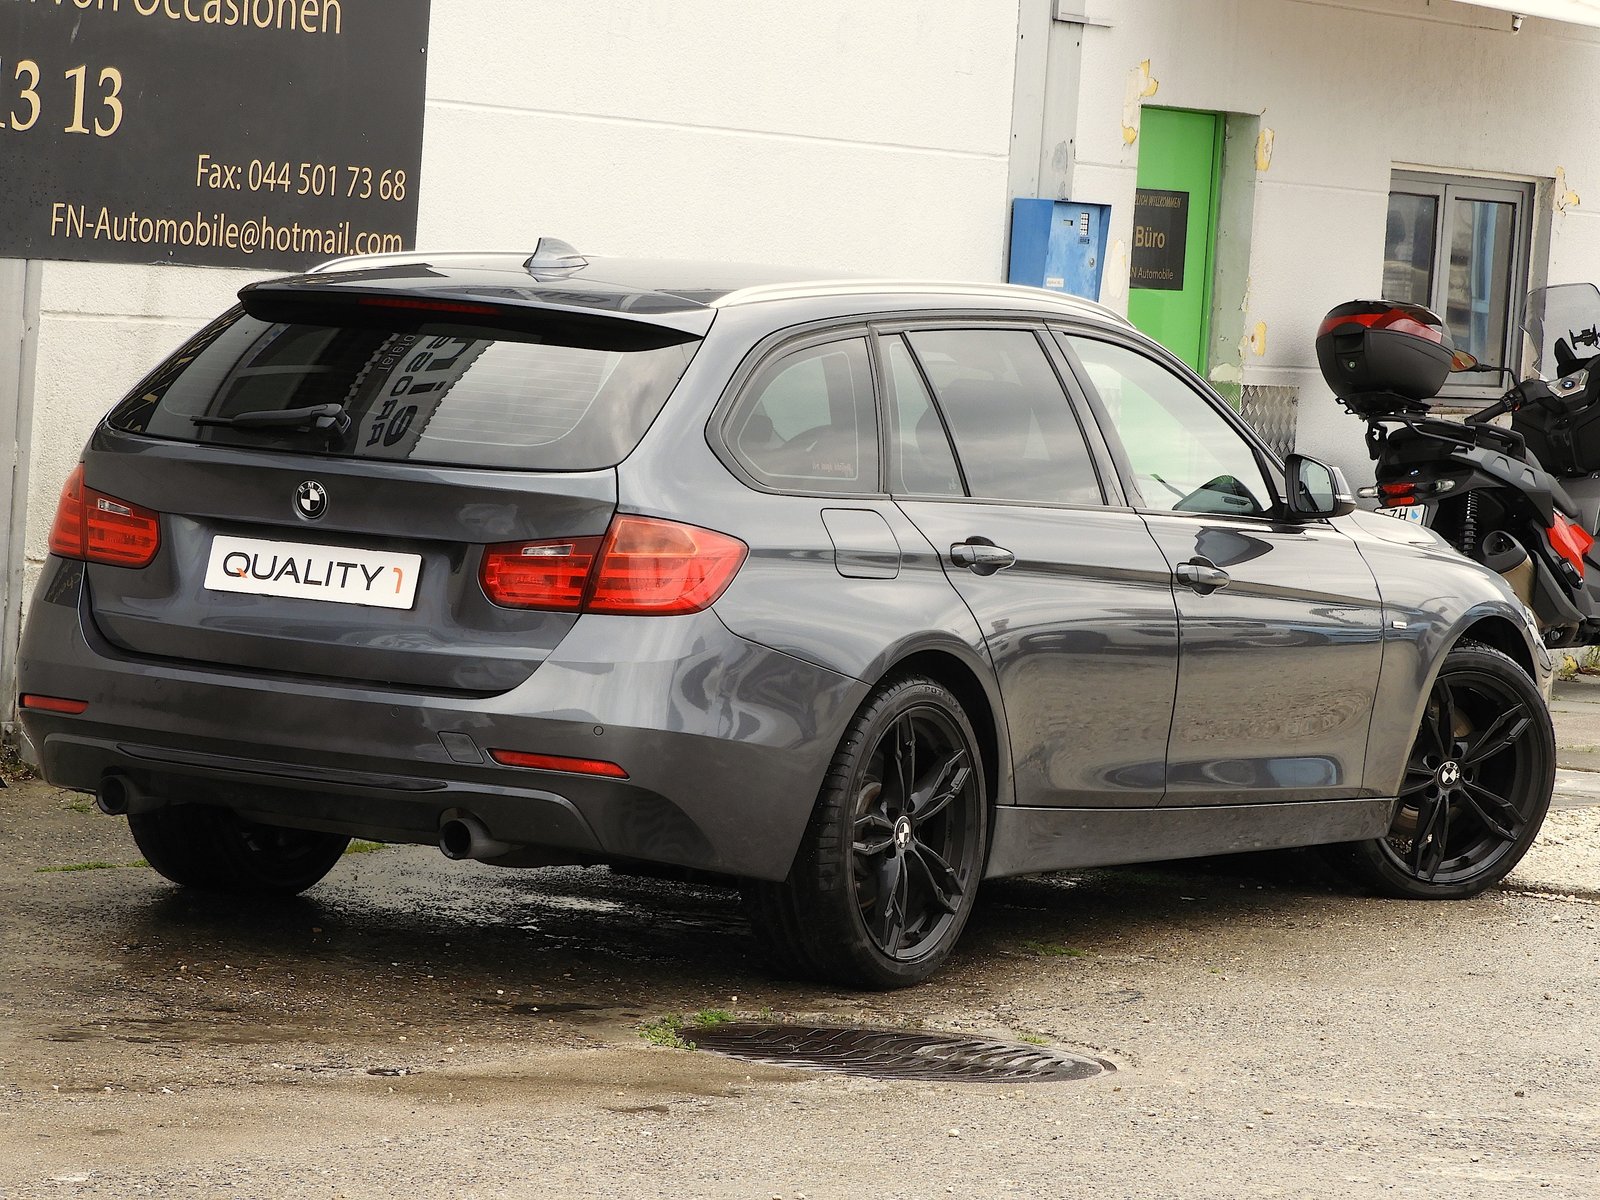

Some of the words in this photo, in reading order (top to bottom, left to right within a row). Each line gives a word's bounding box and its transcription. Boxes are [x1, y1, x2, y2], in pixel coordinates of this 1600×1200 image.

[0, 58, 42, 131] 3
[64, 64, 123, 137] 13
[196, 154, 242, 190] Fax:
[248, 159, 291, 194] 044
[298, 163, 337, 197] 501
[347, 166, 372, 199] 73
[379, 169, 406, 201] 68
[51, 202, 403, 256] FN-Automobile@hotmail.com
[1135, 226, 1166, 249] Büro
[1138, 267, 1174, 280] Automobile
[222, 550, 385, 592] QUALITY
[393, 567, 403, 594] 1
